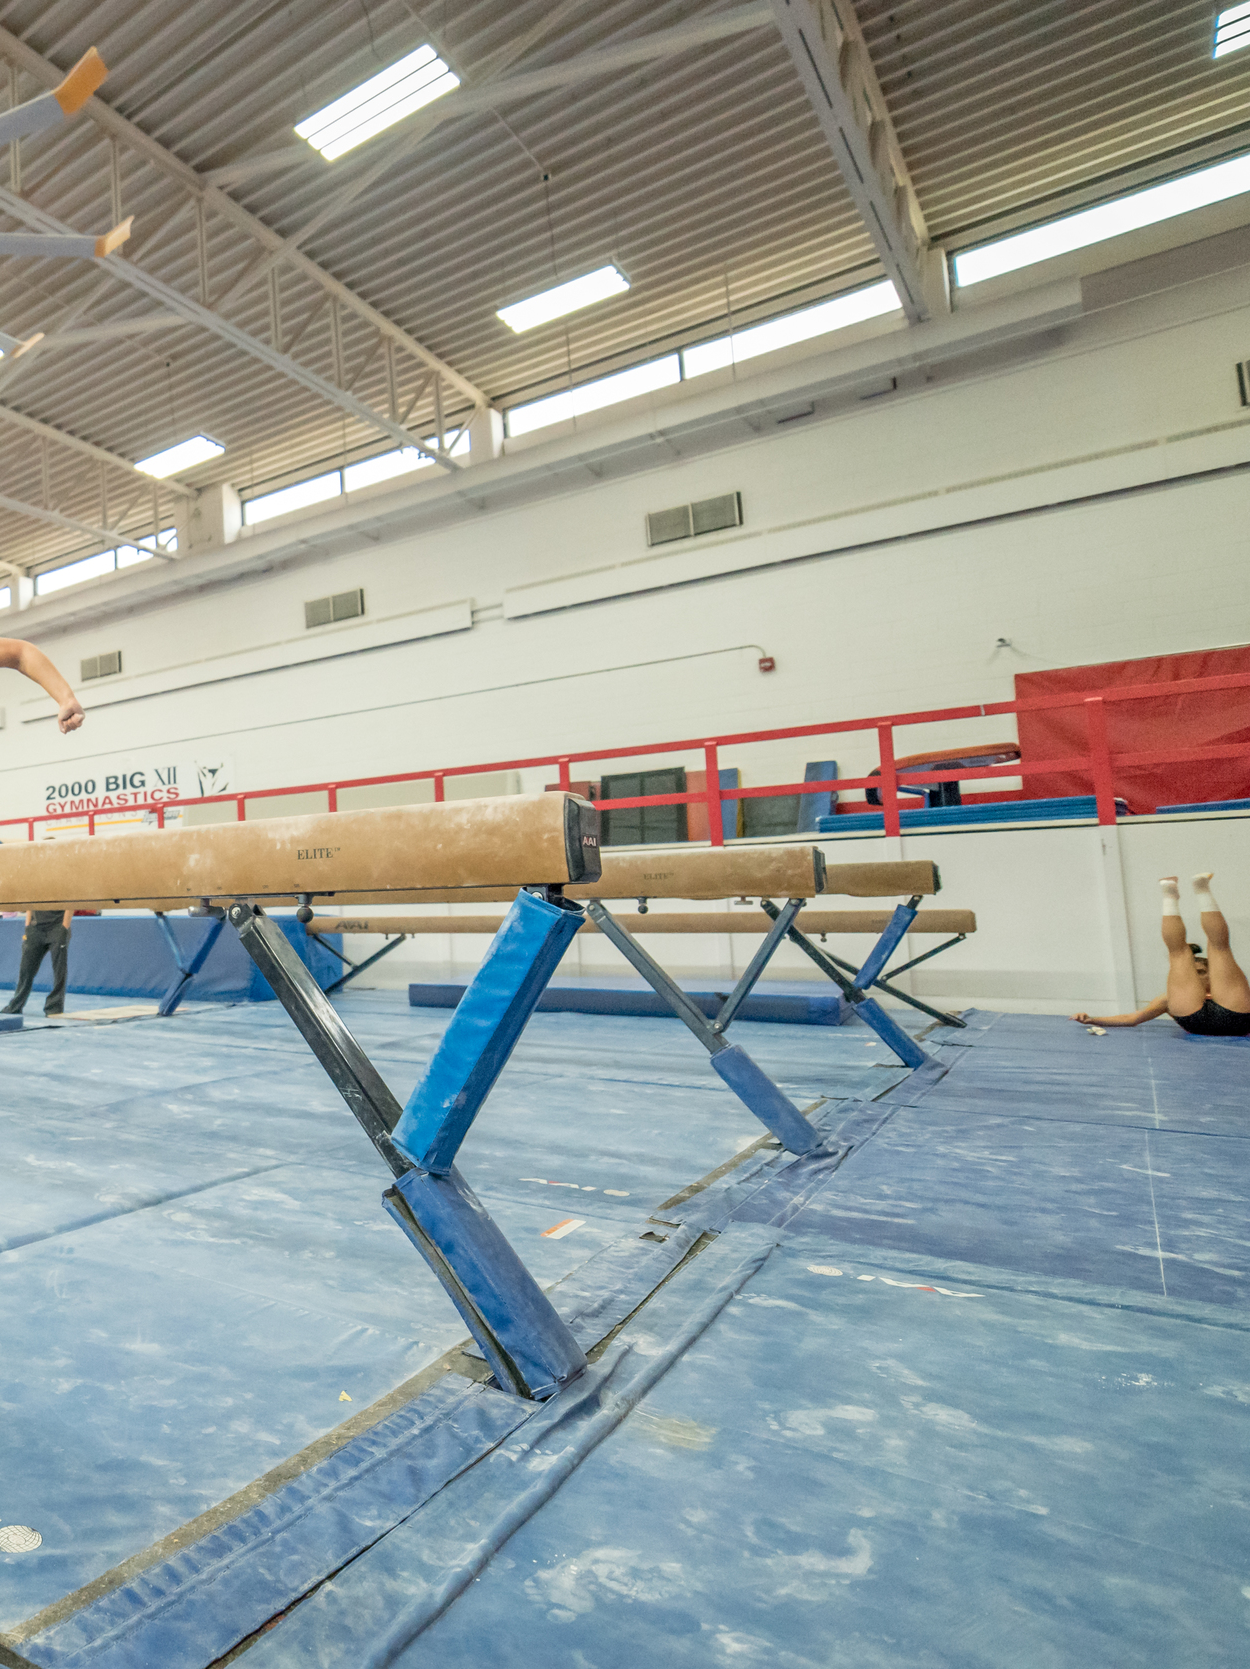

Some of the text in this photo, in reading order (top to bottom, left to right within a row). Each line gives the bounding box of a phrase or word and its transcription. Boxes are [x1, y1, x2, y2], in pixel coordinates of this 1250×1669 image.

[46, 766, 177, 801] 2000 BIG XII
[46, 786, 180, 815] GYMNASTICS
